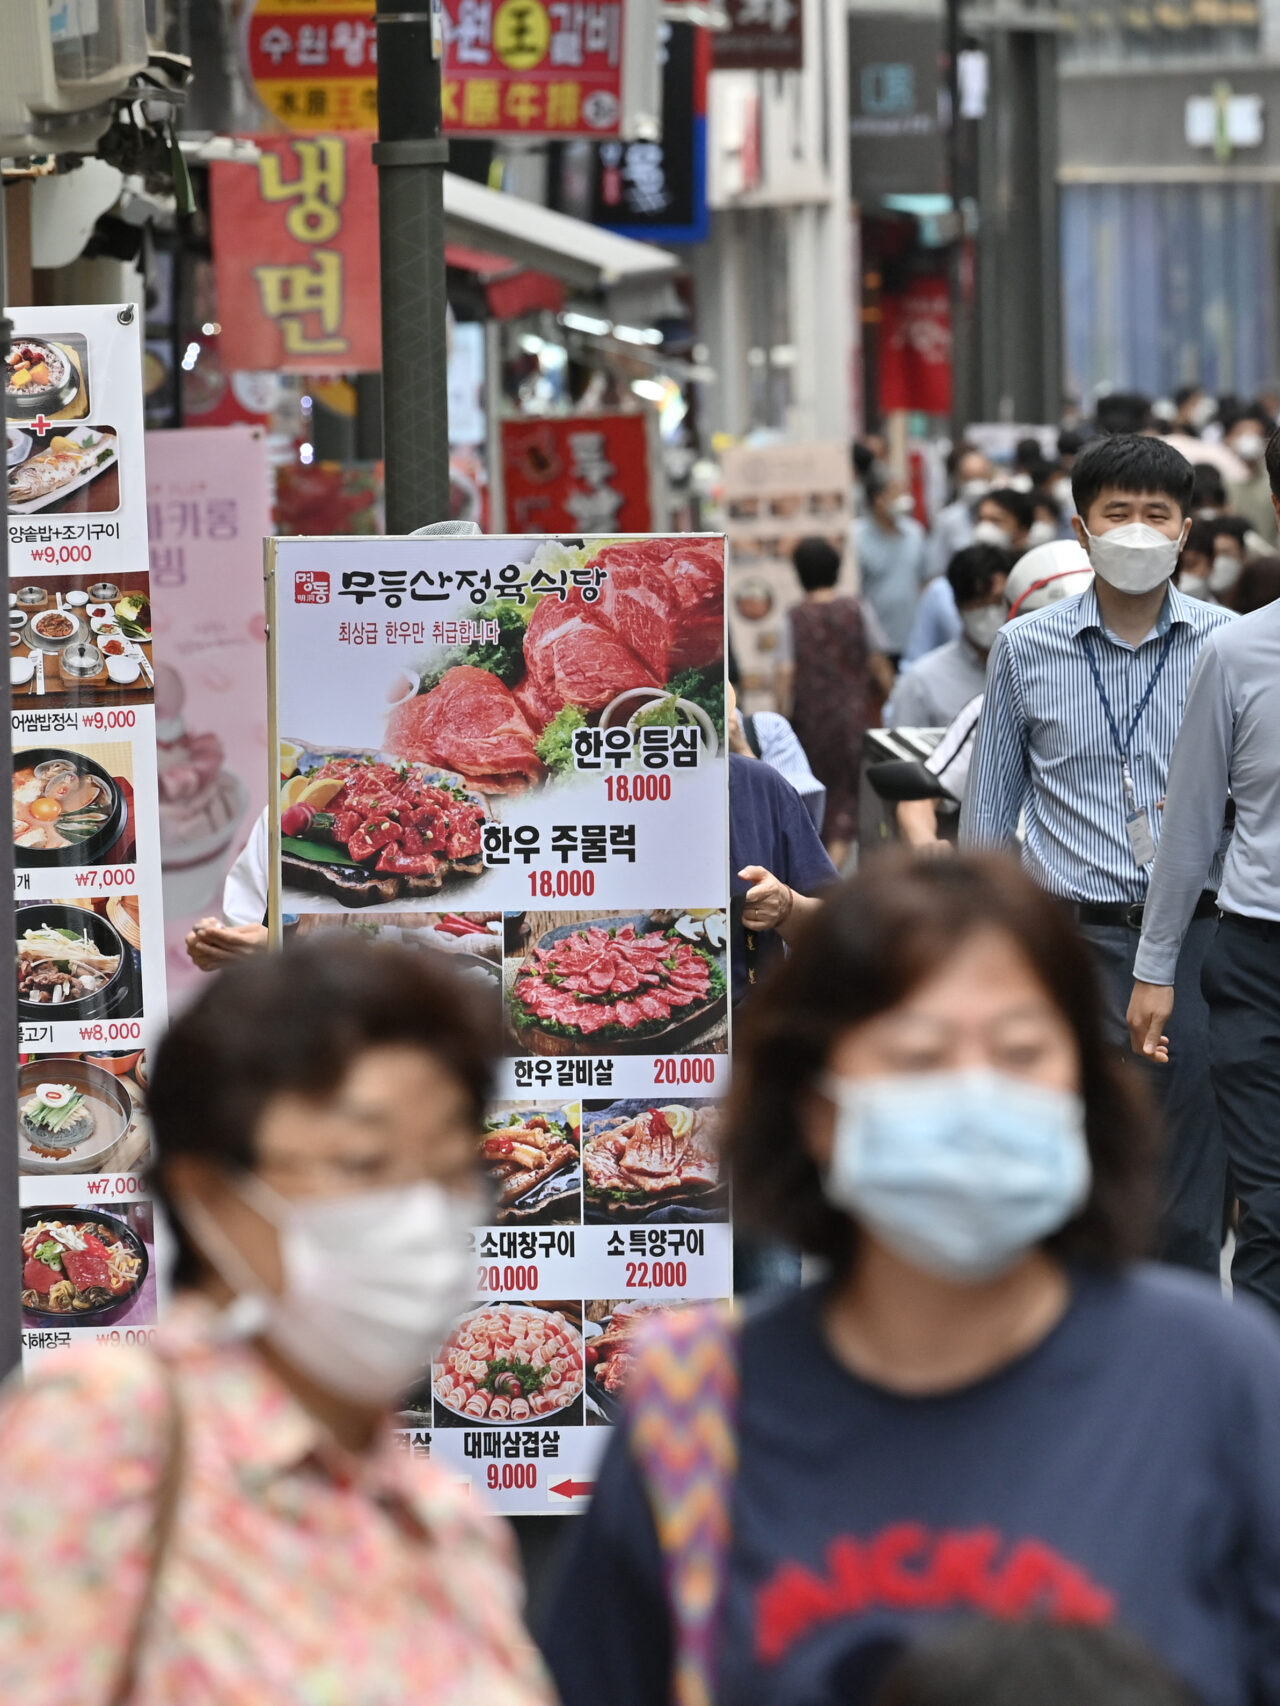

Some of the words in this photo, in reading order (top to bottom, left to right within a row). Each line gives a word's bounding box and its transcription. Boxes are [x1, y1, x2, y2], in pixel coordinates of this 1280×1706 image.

[260, 21, 378, 67] 수원왕
[253, 137, 349, 355] 냉면
[338, 565, 608, 608] 무등산정육식당
[338, 621, 378, 645] 최상급
[385, 620, 425, 645] 한우만
[432, 619, 499, 646] 취급합니다
[574, 728, 632, 770] 한우
[641, 726, 698, 769] 등심
[604, 774, 672, 803] 18,000
[483, 825, 541, 866] 한우
[551, 824, 637, 864] 주물럭
[527, 869, 595, 898] 18,000
[514, 1060, 553, 1088] 한우
[556, 1059, 614, 1087] 갈비살
[653, 1057, 716, 1085] 20,000
[480, 1231, 575, 1259] 소대창구이
[477, 1265, 538, 1292] 20,000
[625, 1261, 688, 1289] 22,000
[463, 1431, 560, 1459] 대패삼겹살
[487, 1463, 538, 1490] 9,000
